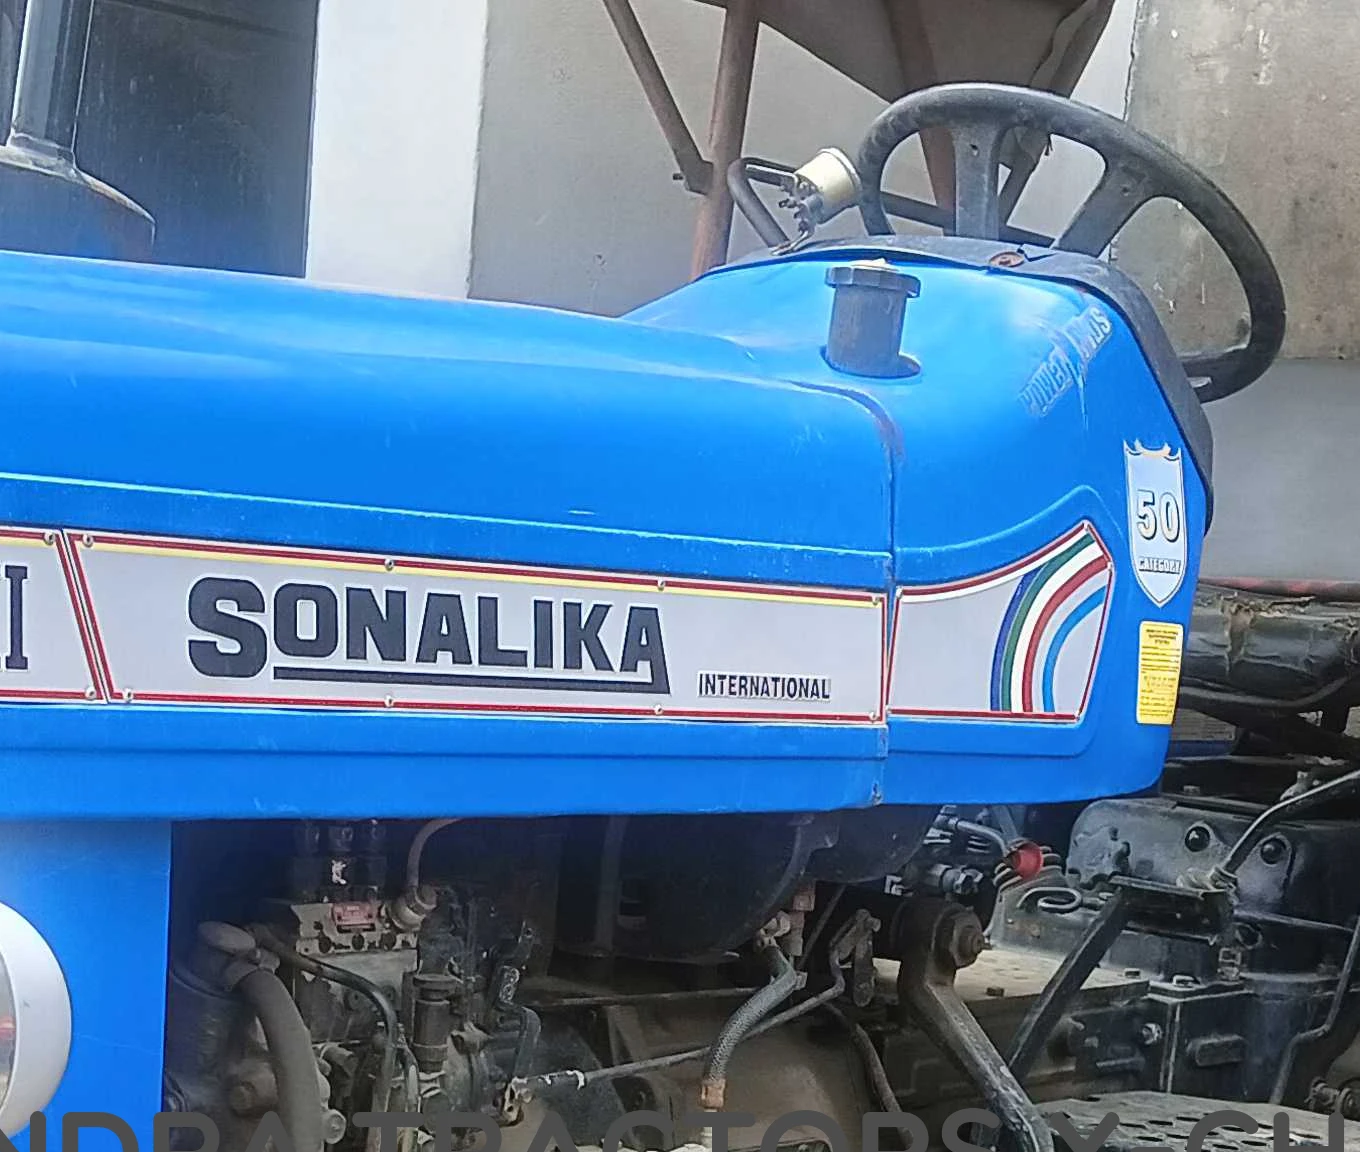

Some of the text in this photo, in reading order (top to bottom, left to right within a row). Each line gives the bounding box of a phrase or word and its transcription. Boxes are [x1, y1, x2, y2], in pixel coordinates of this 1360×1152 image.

[1136, 489, 1180, 543] 50
[187, 576, 671, 695] SONALIKA
[697, 671, 831, 701] INTERNATIONAL
